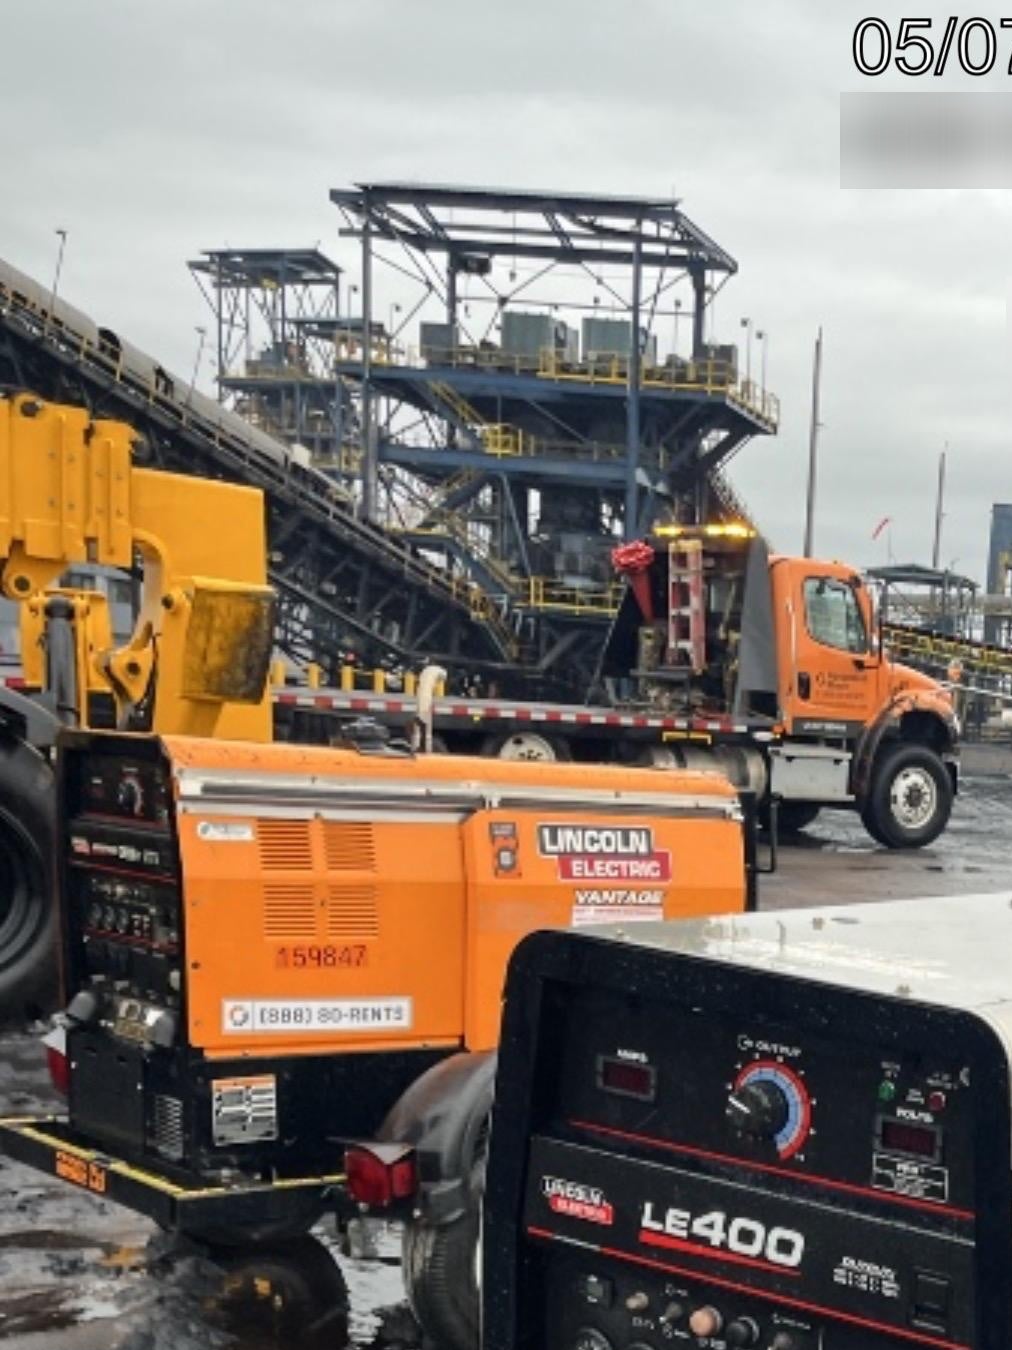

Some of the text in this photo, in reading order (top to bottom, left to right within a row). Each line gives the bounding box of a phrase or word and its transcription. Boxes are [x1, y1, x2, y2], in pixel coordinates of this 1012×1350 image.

[542, 827, 650, 855] LINCOLN
[571, 859, 661, 877] ELECTRIC
[575, 889, 665, 905] VANTAGE
[276, 944, 368, 967] 159847
[259, 1006, 313, 1025] (888)
[640, 1202, 805, 1268] LE400
